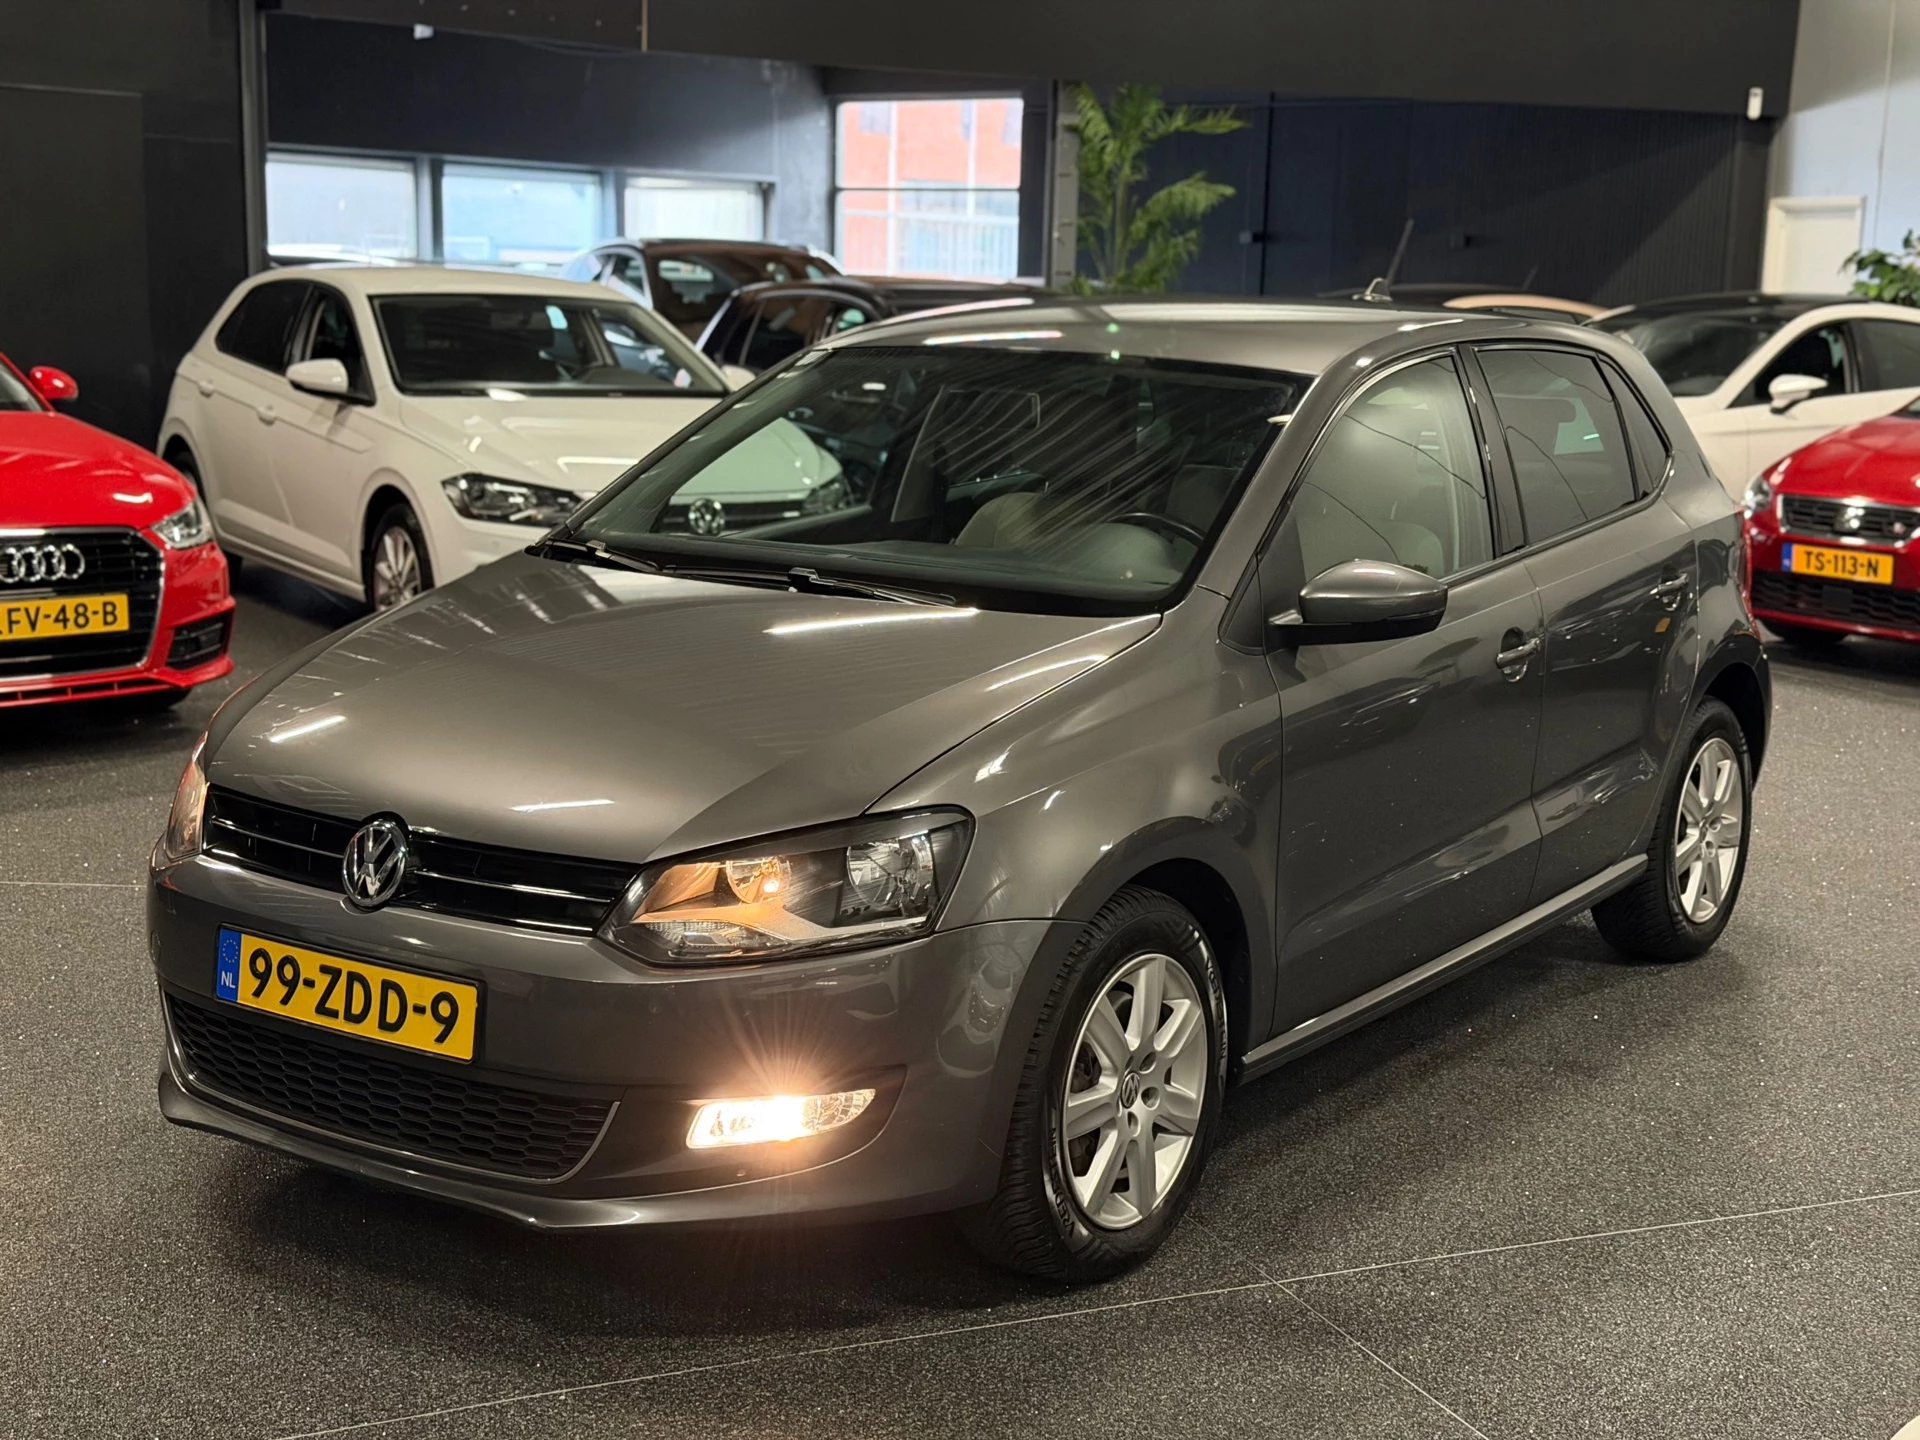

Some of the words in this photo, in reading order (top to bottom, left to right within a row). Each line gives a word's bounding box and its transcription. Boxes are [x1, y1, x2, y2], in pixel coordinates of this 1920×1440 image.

[1804, 550, 1880, 578] TS-113-N
[0, 601, 118, 635] FV-48-B
[220, 970, 236, 989] NL
[248, 947, 460, 1044] 99-ZDD-9
